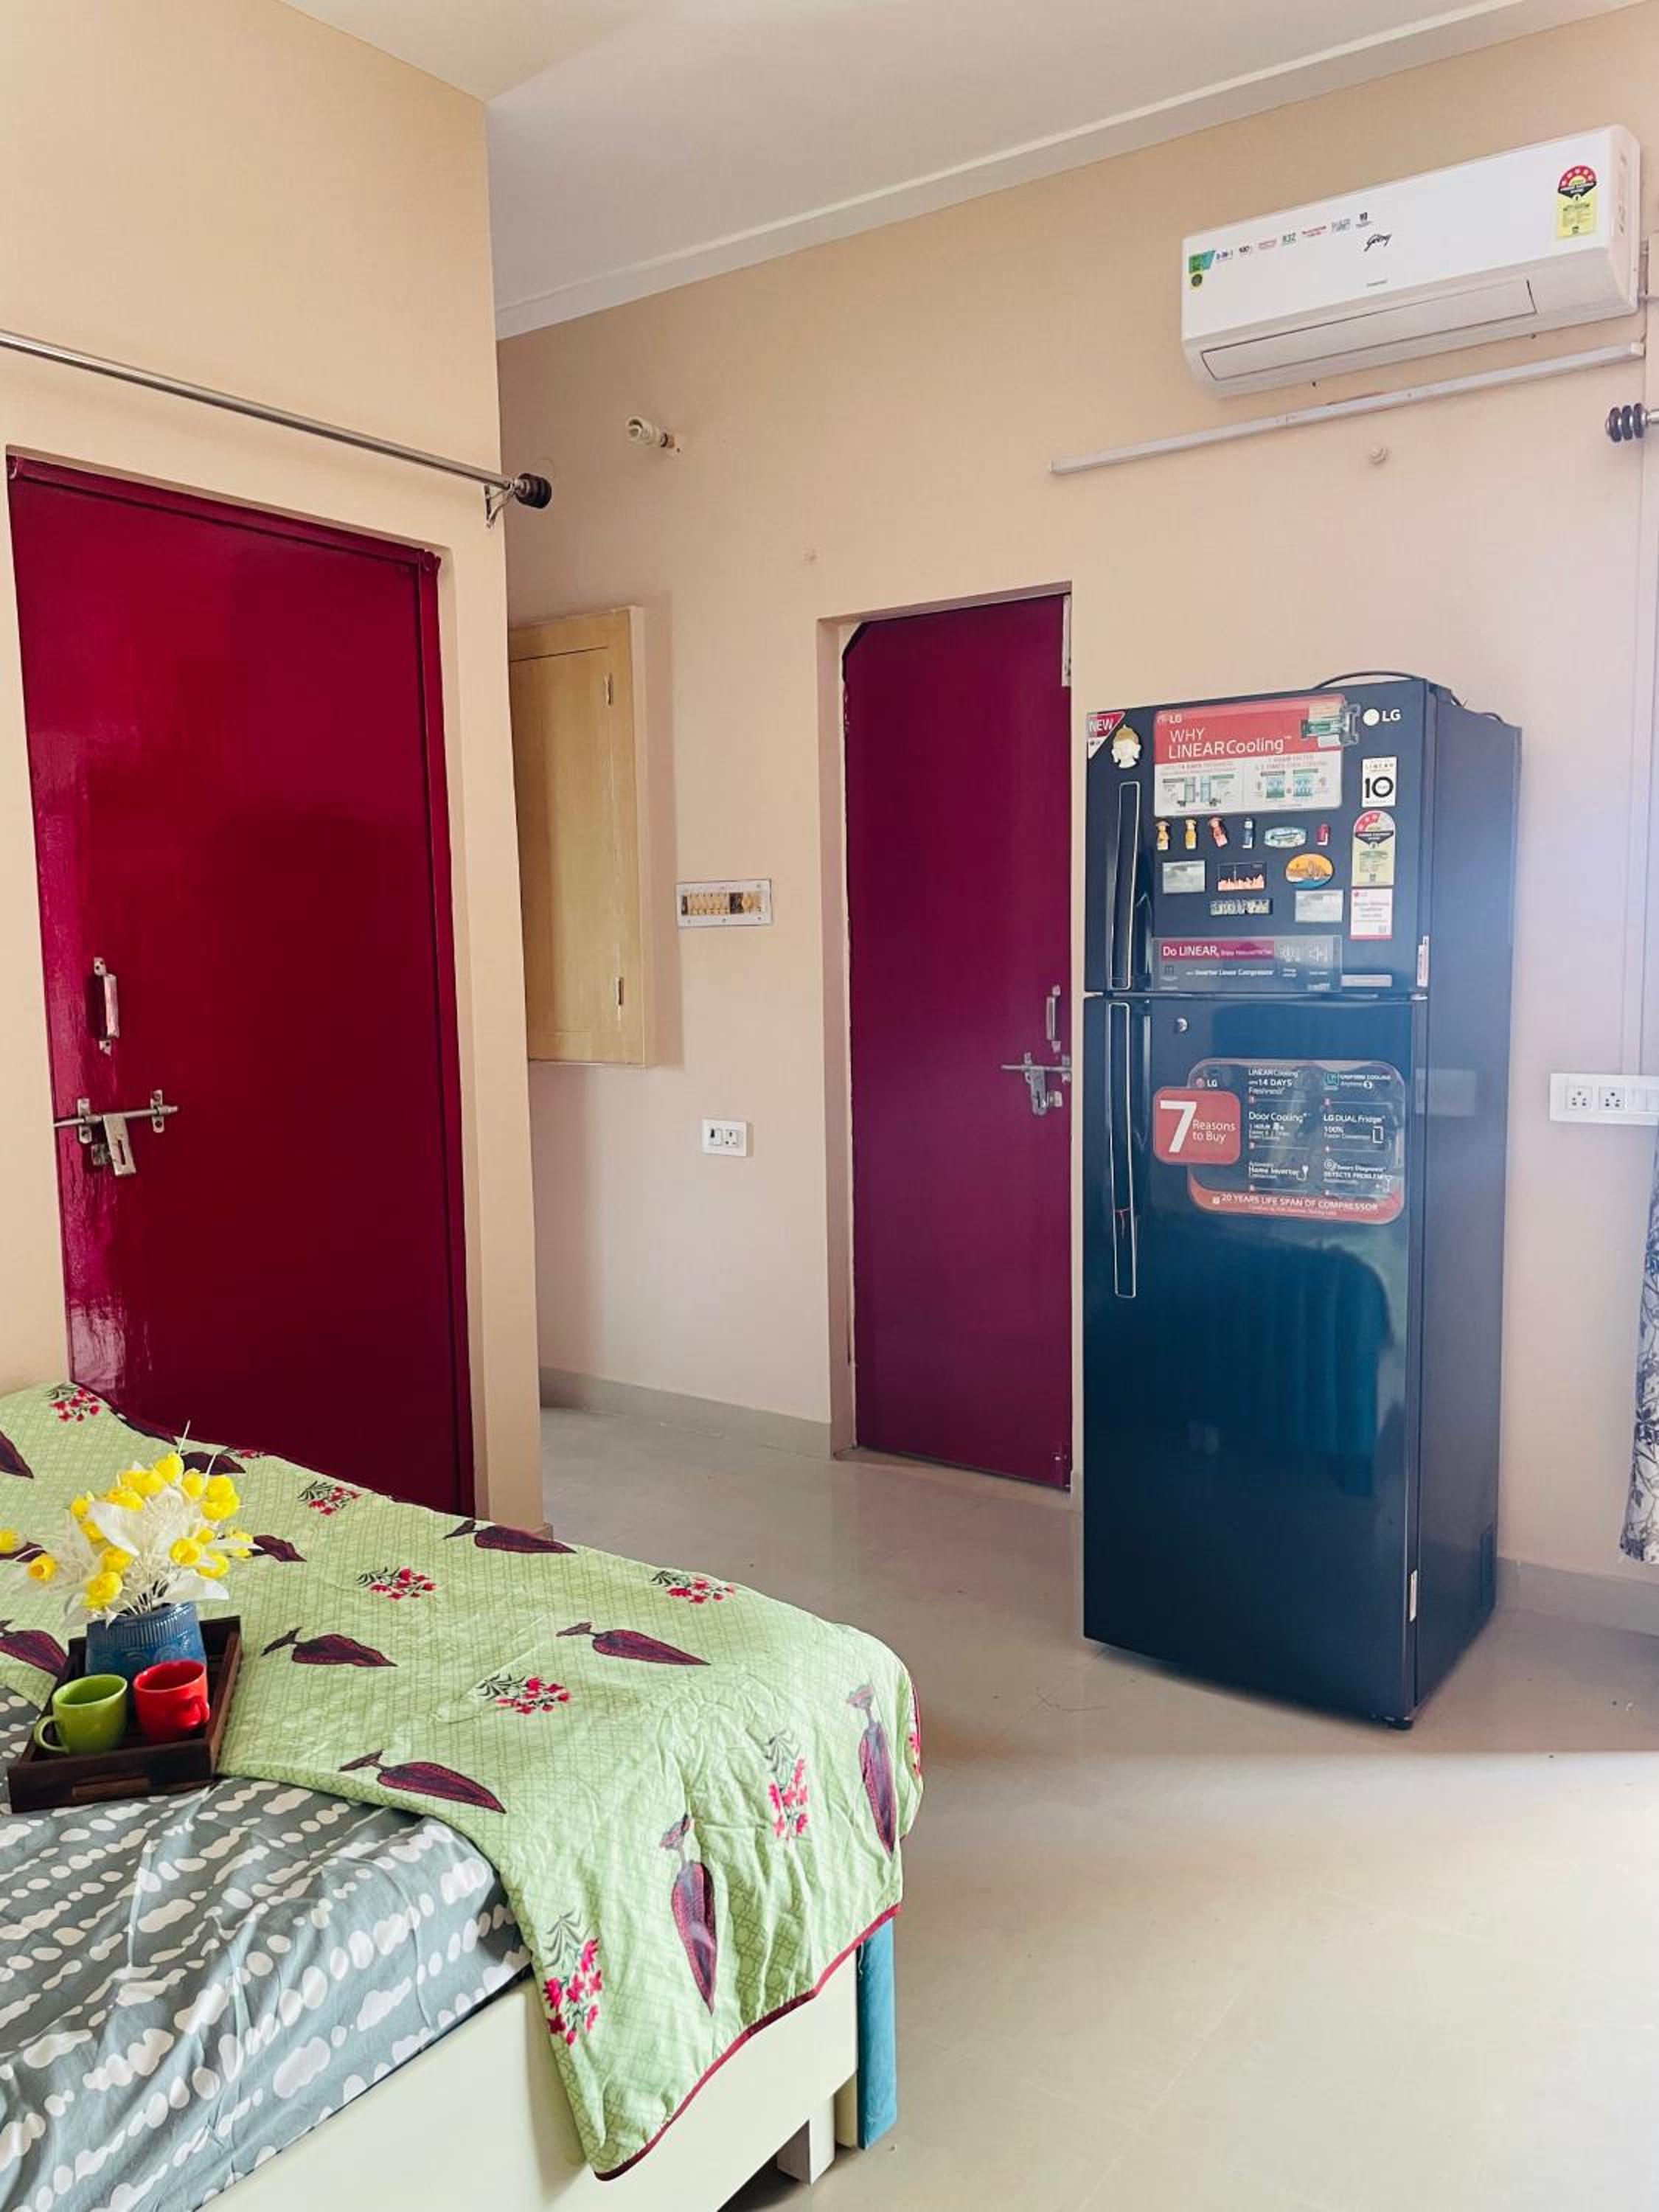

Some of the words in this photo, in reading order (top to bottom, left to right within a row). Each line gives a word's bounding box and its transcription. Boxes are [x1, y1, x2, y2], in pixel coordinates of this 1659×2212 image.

[1381, 709, 1402, 722] LG
[1089, 717, 1115, 732] NEW
[1169, 726, 1206, 742] WHY
[1365, 776, 1394, 799] 10
[1162, 946, 1178, 956] Do
[1207, 1079, 1218, 1088] LG
[1270, 1079, 1293, 1087] DAYS
[1160, 1099, 1197, 1153] 7
[1192, 1119, 1237, 1132] Reasons
[1192, 1131, 1204, 1141] to
[1206, 1131, 1226, 1144] Buy
[1220, 1193, 1232, 1202] 20
[1233, 1194, 1259, 1205] YEARS
[1261, 1196, 1278, 1206] LIFE
[1318, 1200, 1378, 1211] COMPRESSOR
